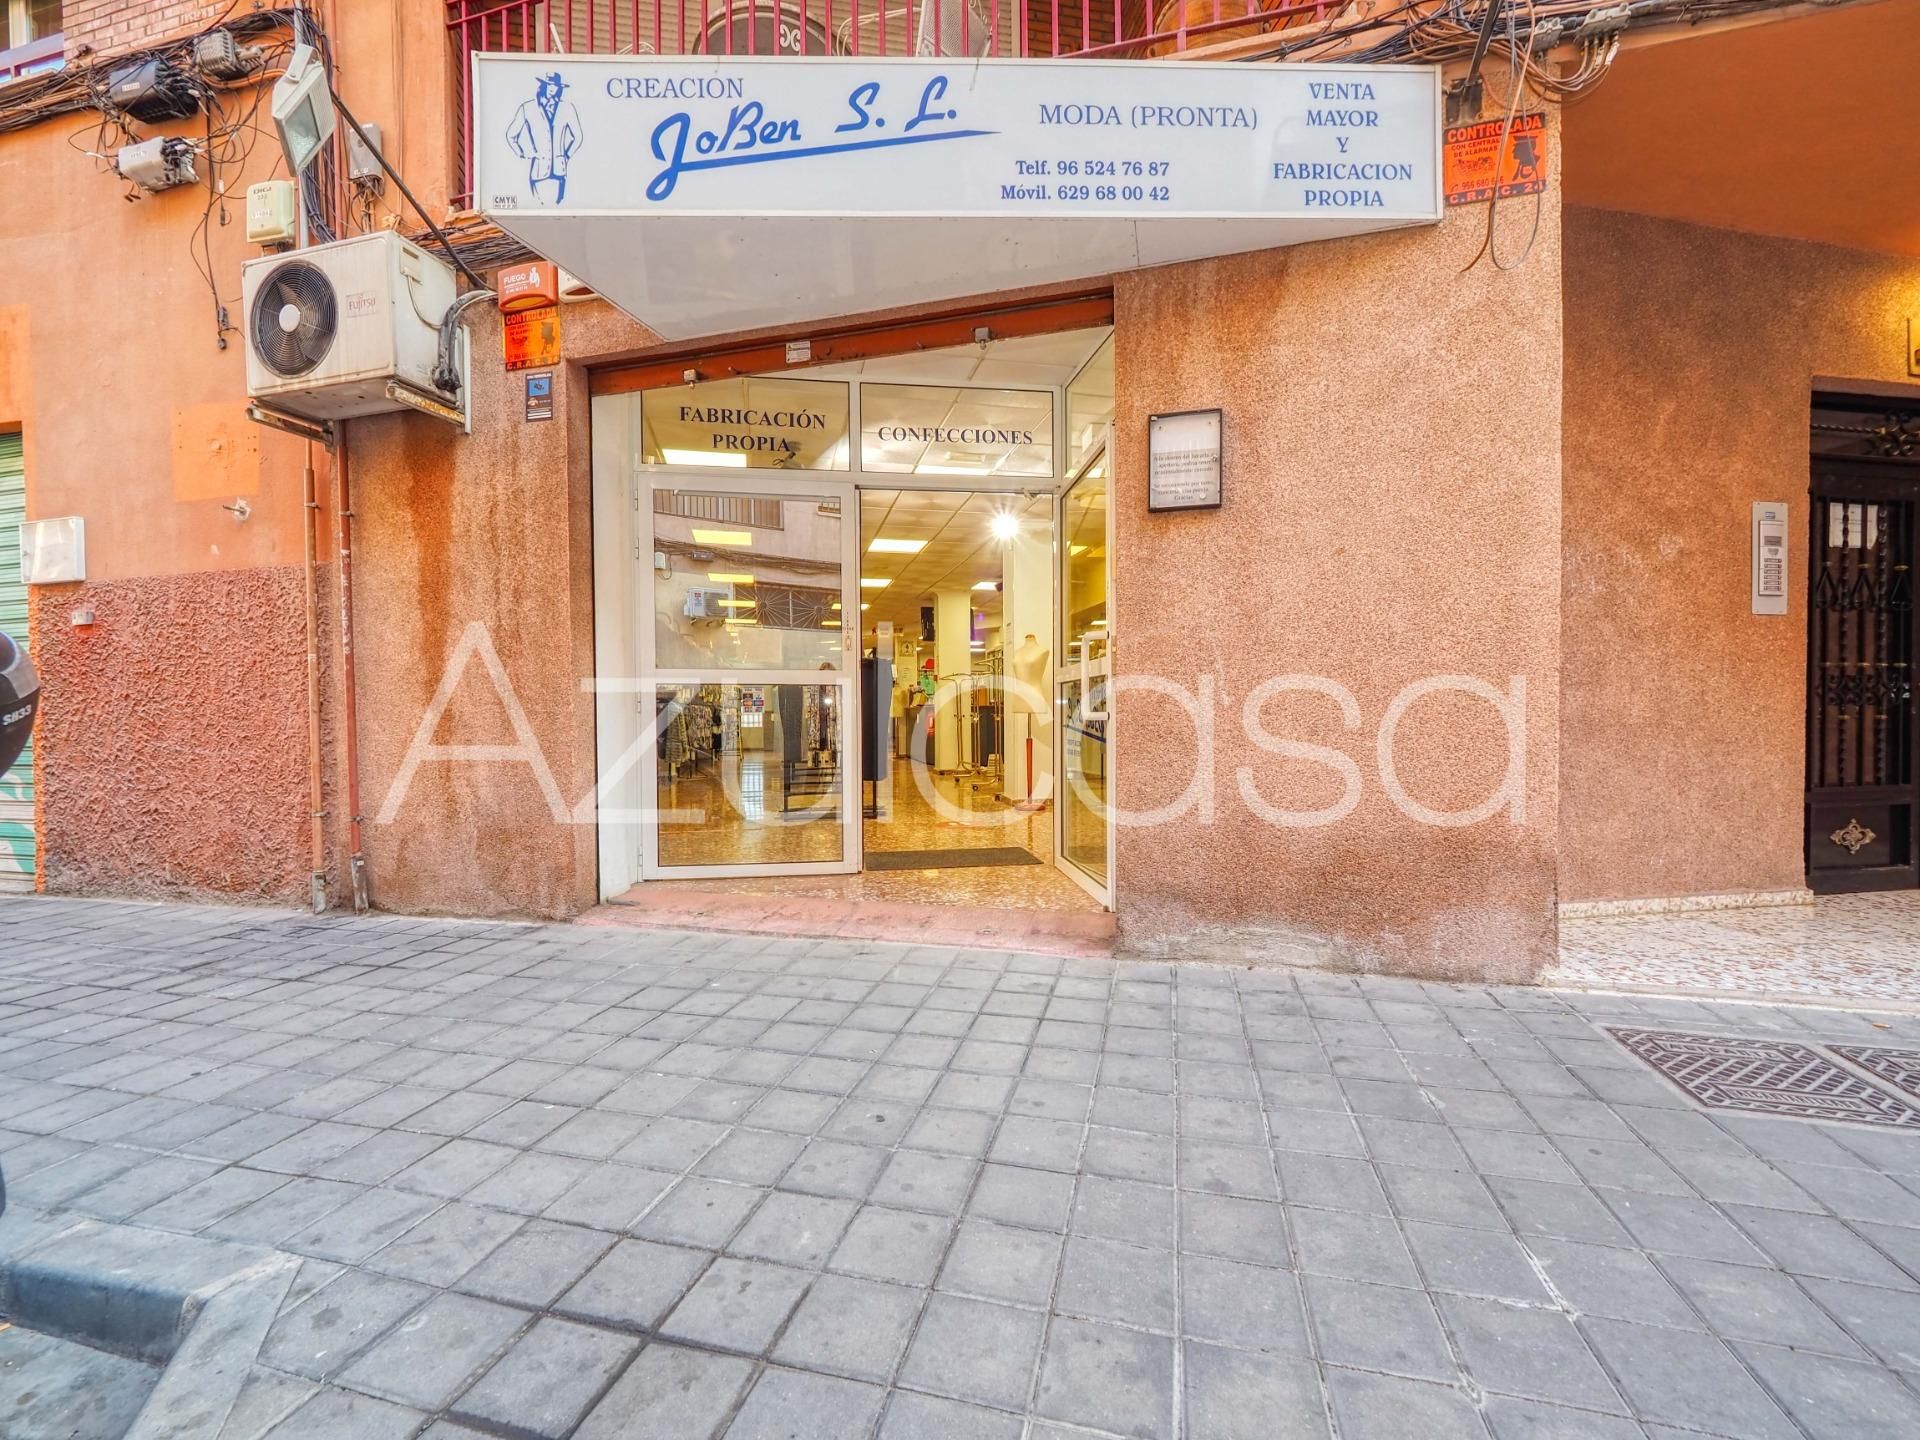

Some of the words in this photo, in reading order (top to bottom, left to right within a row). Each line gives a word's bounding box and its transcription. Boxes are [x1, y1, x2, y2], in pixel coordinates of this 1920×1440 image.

[606, 77, 744, 99] CREACION
[1308, 82, 1376, 101] VENTA
[1039, 103, 1122, 126] MODA
[1131, 105, 1258, 131] (PRONTA)
[1306, 109, 1379, 128] MAYOR
[645, 100, 801, 202] JoBen
[834, 81, 886, 133] S.
[903, 75, 958, 132] L.
[1447, 115, 1542, 143] CONTROADA
[1335, 136, 1350, 154] Y
[1015, 159, 1051, 176] Telf.
[1056, 160, 1079, 176] 96
[1084, 160, 1117, 176] 524
[1121, 161, 1143, 177] 76
[1148, 161, 1170, 177] 87
[1273, 162, 1412, 182] FABRICACION
[1000, 182, 1052, 200] Móvil.
[1057, 184, 1090, 201] 629
[1095, 185, 1117, 201] 68
[1121, 185, 1144, 201] 00
[1148, 185, 1170, 201] 42
[1304, 189, 1385, 207] PROPIA
[504, 273, 527, 285] FUEGO
[506, 308, 557, 325] CONTROLADA
[679, 406, 826, 430] FABRICACIÓN
[712, 433, 791, 453] PROPIA
[878, 426, 1033, 446] CONFECCIONES
